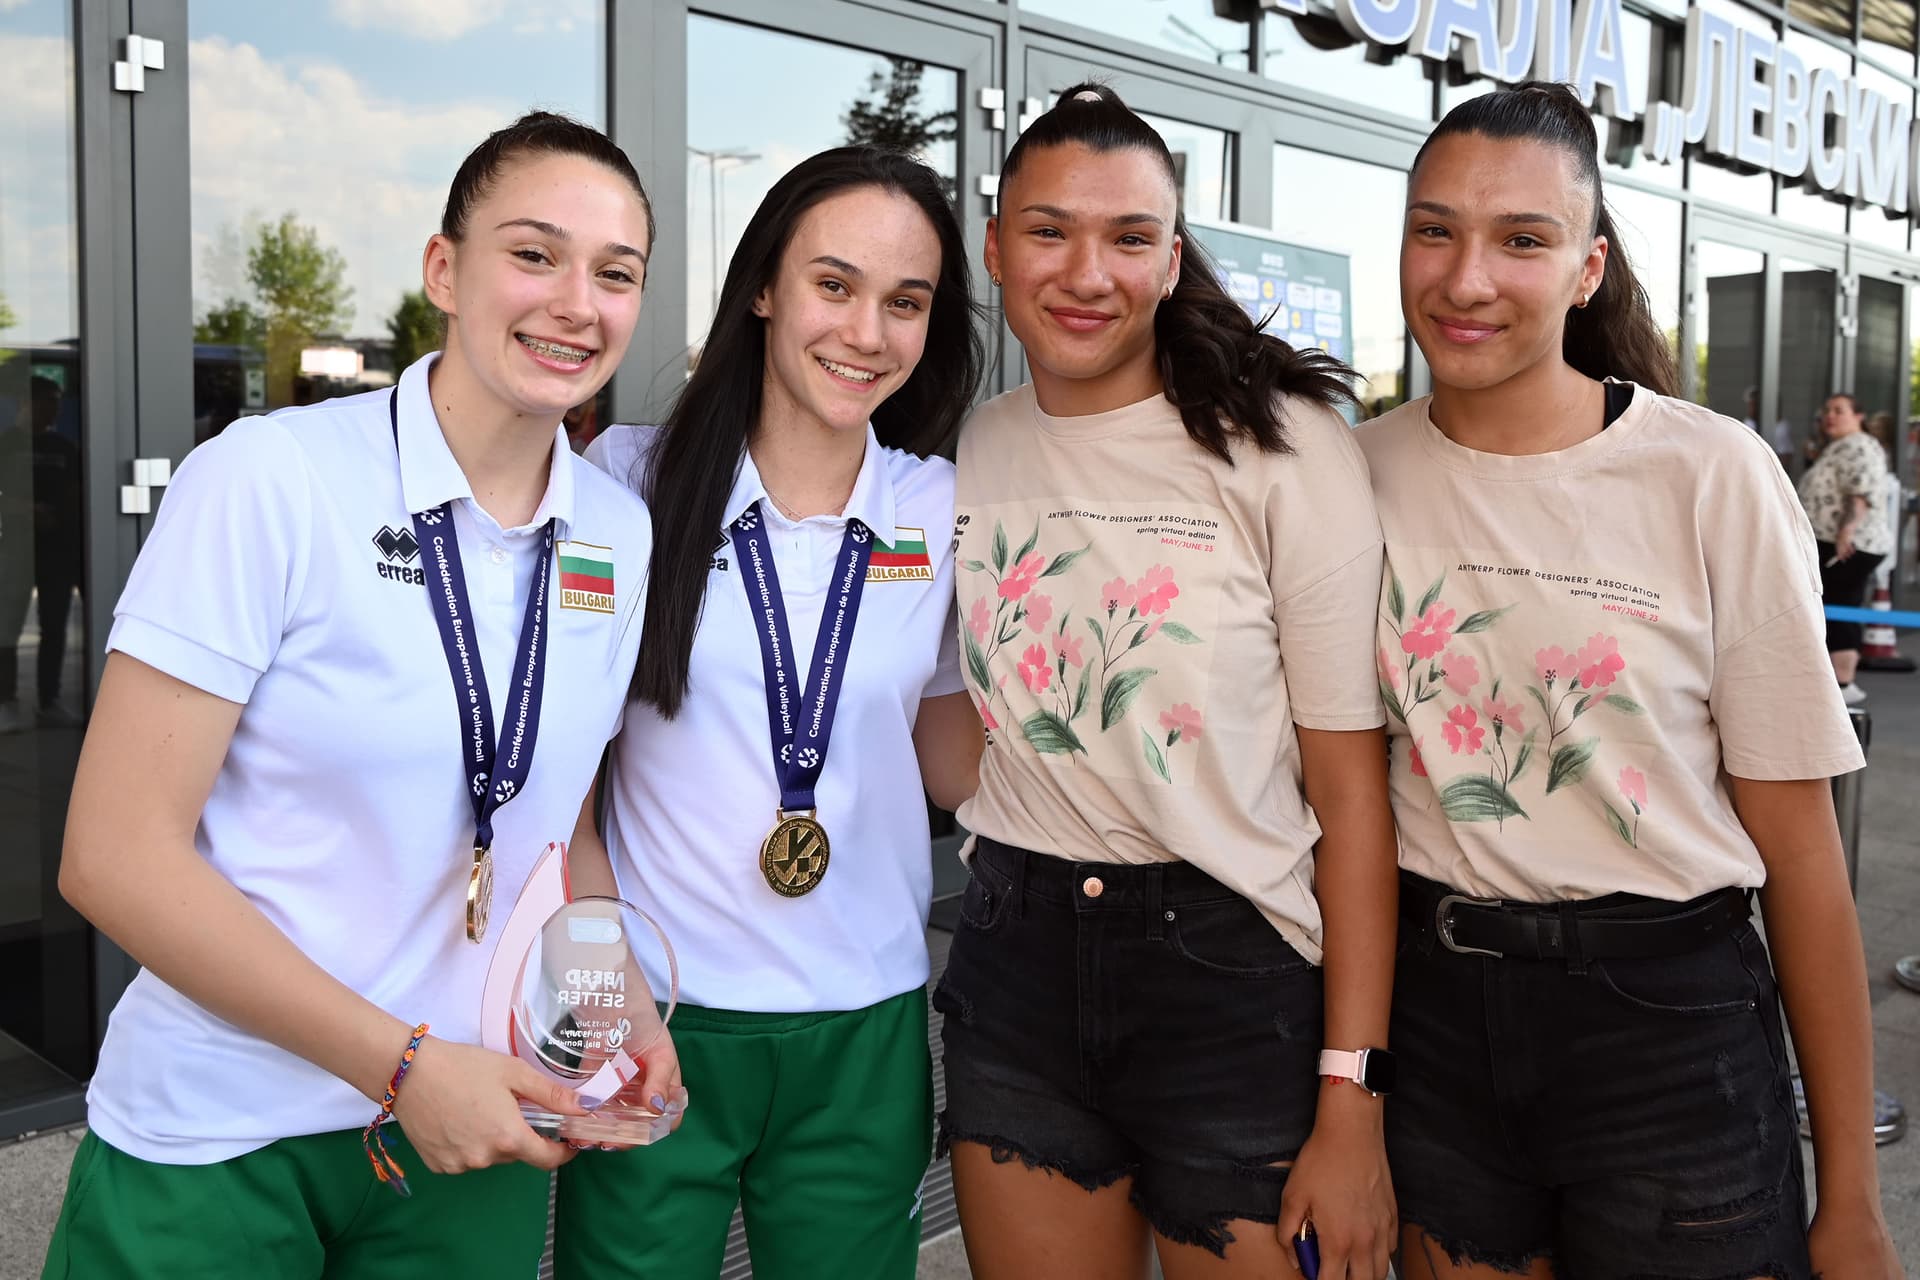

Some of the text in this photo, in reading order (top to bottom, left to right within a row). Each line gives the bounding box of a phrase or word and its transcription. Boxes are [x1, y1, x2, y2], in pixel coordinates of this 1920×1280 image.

[1349, 0, 1633, 120] ЛА
[1075, 510, 1107, 522] FLOWER
[1158, 515, 1218, 528] ASSOCIATION
[1136, 526, 1216, 540] spring virtual edition
[1160, 538, 1202, 550] MAY/JUNE
[841, 550, 859, 594] Volleyball
[866, 567, 930, 579] BULGARIA
[1458, 564, 1494, 573] ANTWERP
[1497, 568, 1530, 576] FLOWER
[1596, 578, 1660, 600] ASSOCIATION
[838, 596, 848, 608] de
[1570, 588, 1660, 610] spring virtual edition
[534, 609, 542, 622] de
[1602, 604, 1647, 619] MAY/JUNE
[777, 670, 786, 683] de
[469, 688, 478, 704] de
[779, 685, 792, 734] Volleyball
[472, 705, 484, 762] Volleyball
